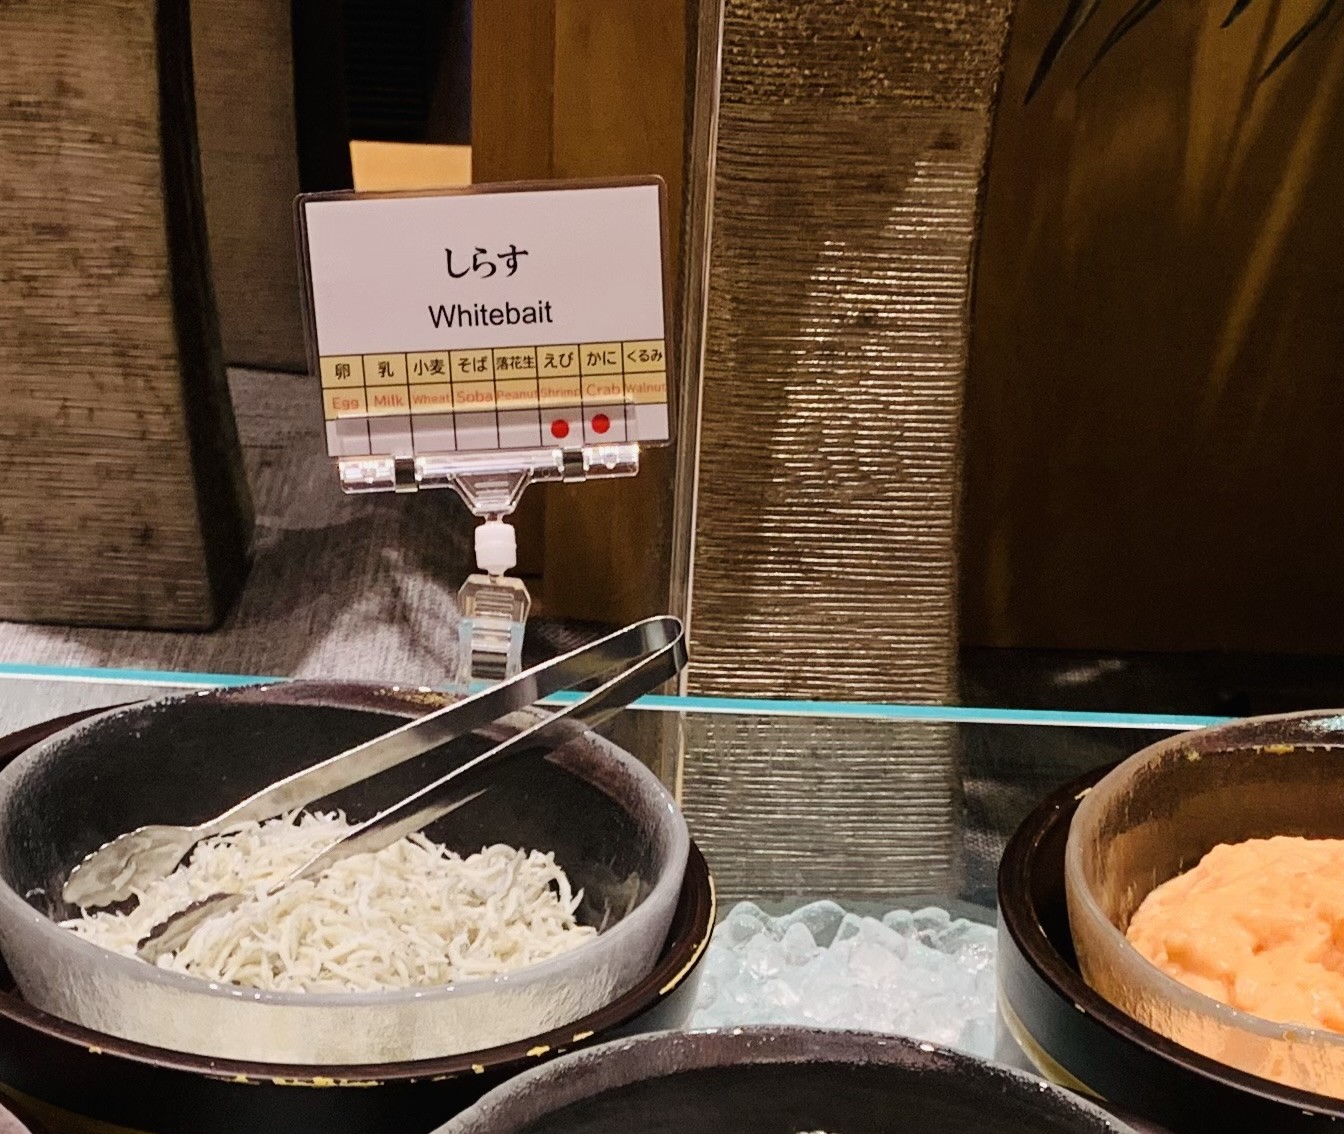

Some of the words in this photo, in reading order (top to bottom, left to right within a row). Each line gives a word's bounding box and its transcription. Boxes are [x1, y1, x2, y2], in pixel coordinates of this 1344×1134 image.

[444, 244, 529, 279] しらす
[428, 300, 553, 329] Whitebait
[335, 363, 351, 380] 卵
[378, 360, 394, 378] 乳
[413, 358, 446, 376] 小麦
[458, 356, 488, 373] そば
[497, 355, 536, 370] 落花生
[544, 351, 574, 369] えび
[587, 350, 617, 367] かに
[627, 348, 663, 363] くるみ
[332, 397, 360, 411] Egg
[374, 394, 404, 407] Milk
[412, 393, 450, 405] Wheat
[457, 389, 493, 404] Soba
[586, 382, 621, 397] Crab
[625, 381, 666, 394] Walnut
